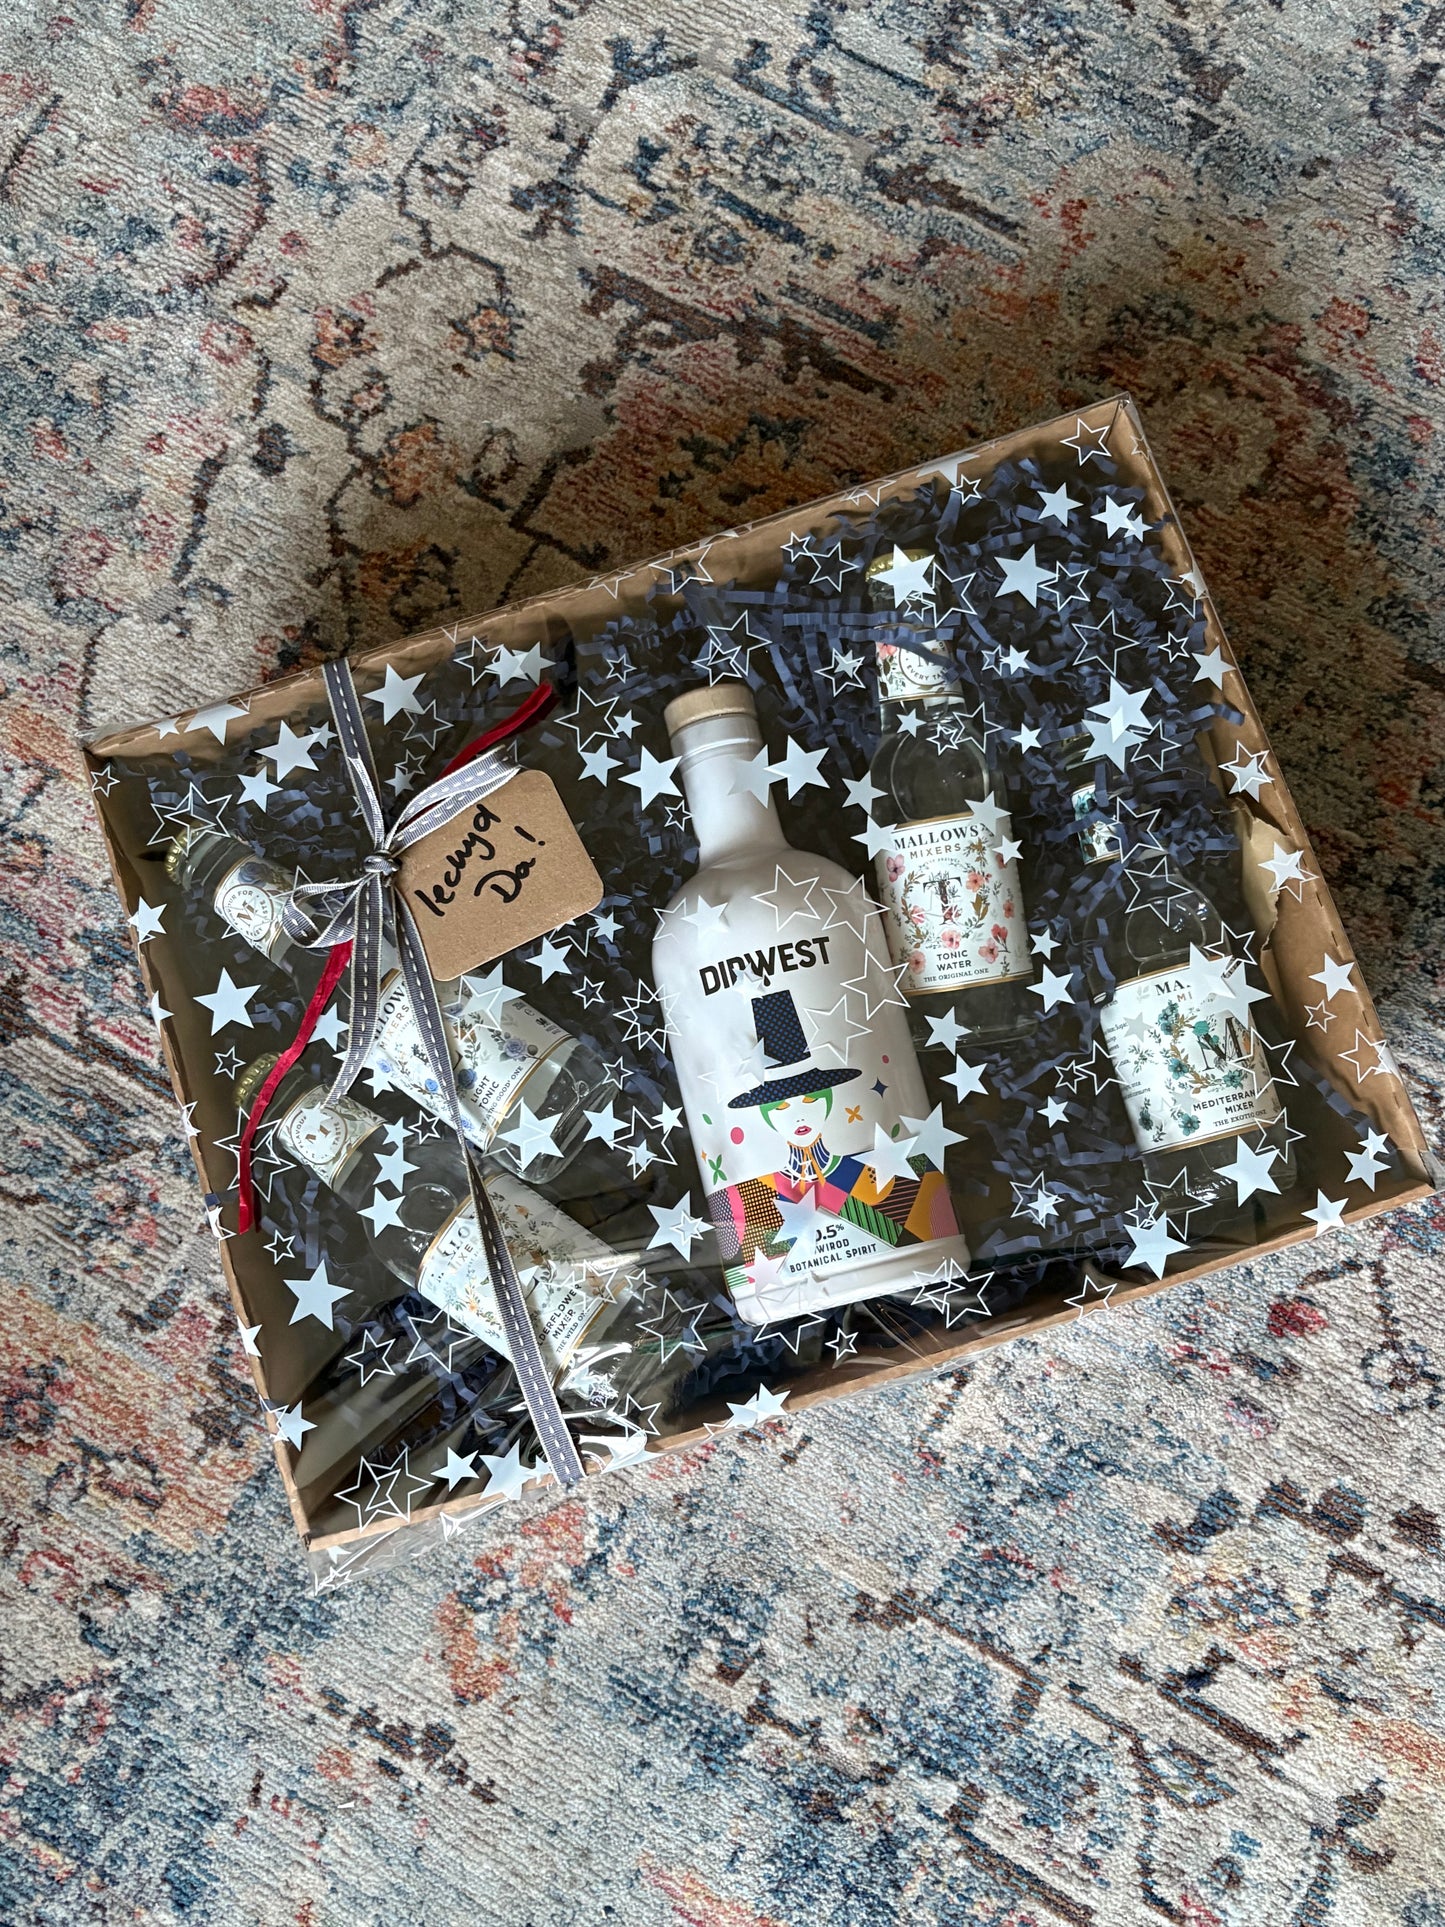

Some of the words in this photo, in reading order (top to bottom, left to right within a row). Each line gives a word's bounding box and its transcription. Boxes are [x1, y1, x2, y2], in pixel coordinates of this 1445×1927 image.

[893, 825, 979, 851] MALLOWS
[909, 842, 962, 860] MIXERS
[936, 949, 969, 962] TONIC
[923, 974, 938, 983] THE
[938, 970, 973, 981] ORIGINAL
[973, 967, 990, 975] ONE
[936, 960, 972, 972] WATER
[379, 1004, 410, 1050] MIXERS
[510, 1065, 524, 1080] ONE
[470, 1075, 491, 1104] LIGHT
[478, 1080, 500, 1110] TONIC
[1224, 1100, 1255, 1115] MIXER
[1213, 1118, 1230, 1127] THE
[1230, 1112, 1255, 1123] EXOTIC
[814, 1237, 850, 1254] WIROD
[789, 1252, 843, 1273] BOTANICAL
[846, 1242, 878, 1259] SPIRIT
[552, 1308, 577, 1340] MIXER
[564, 1321, 579, 1339] WILD
